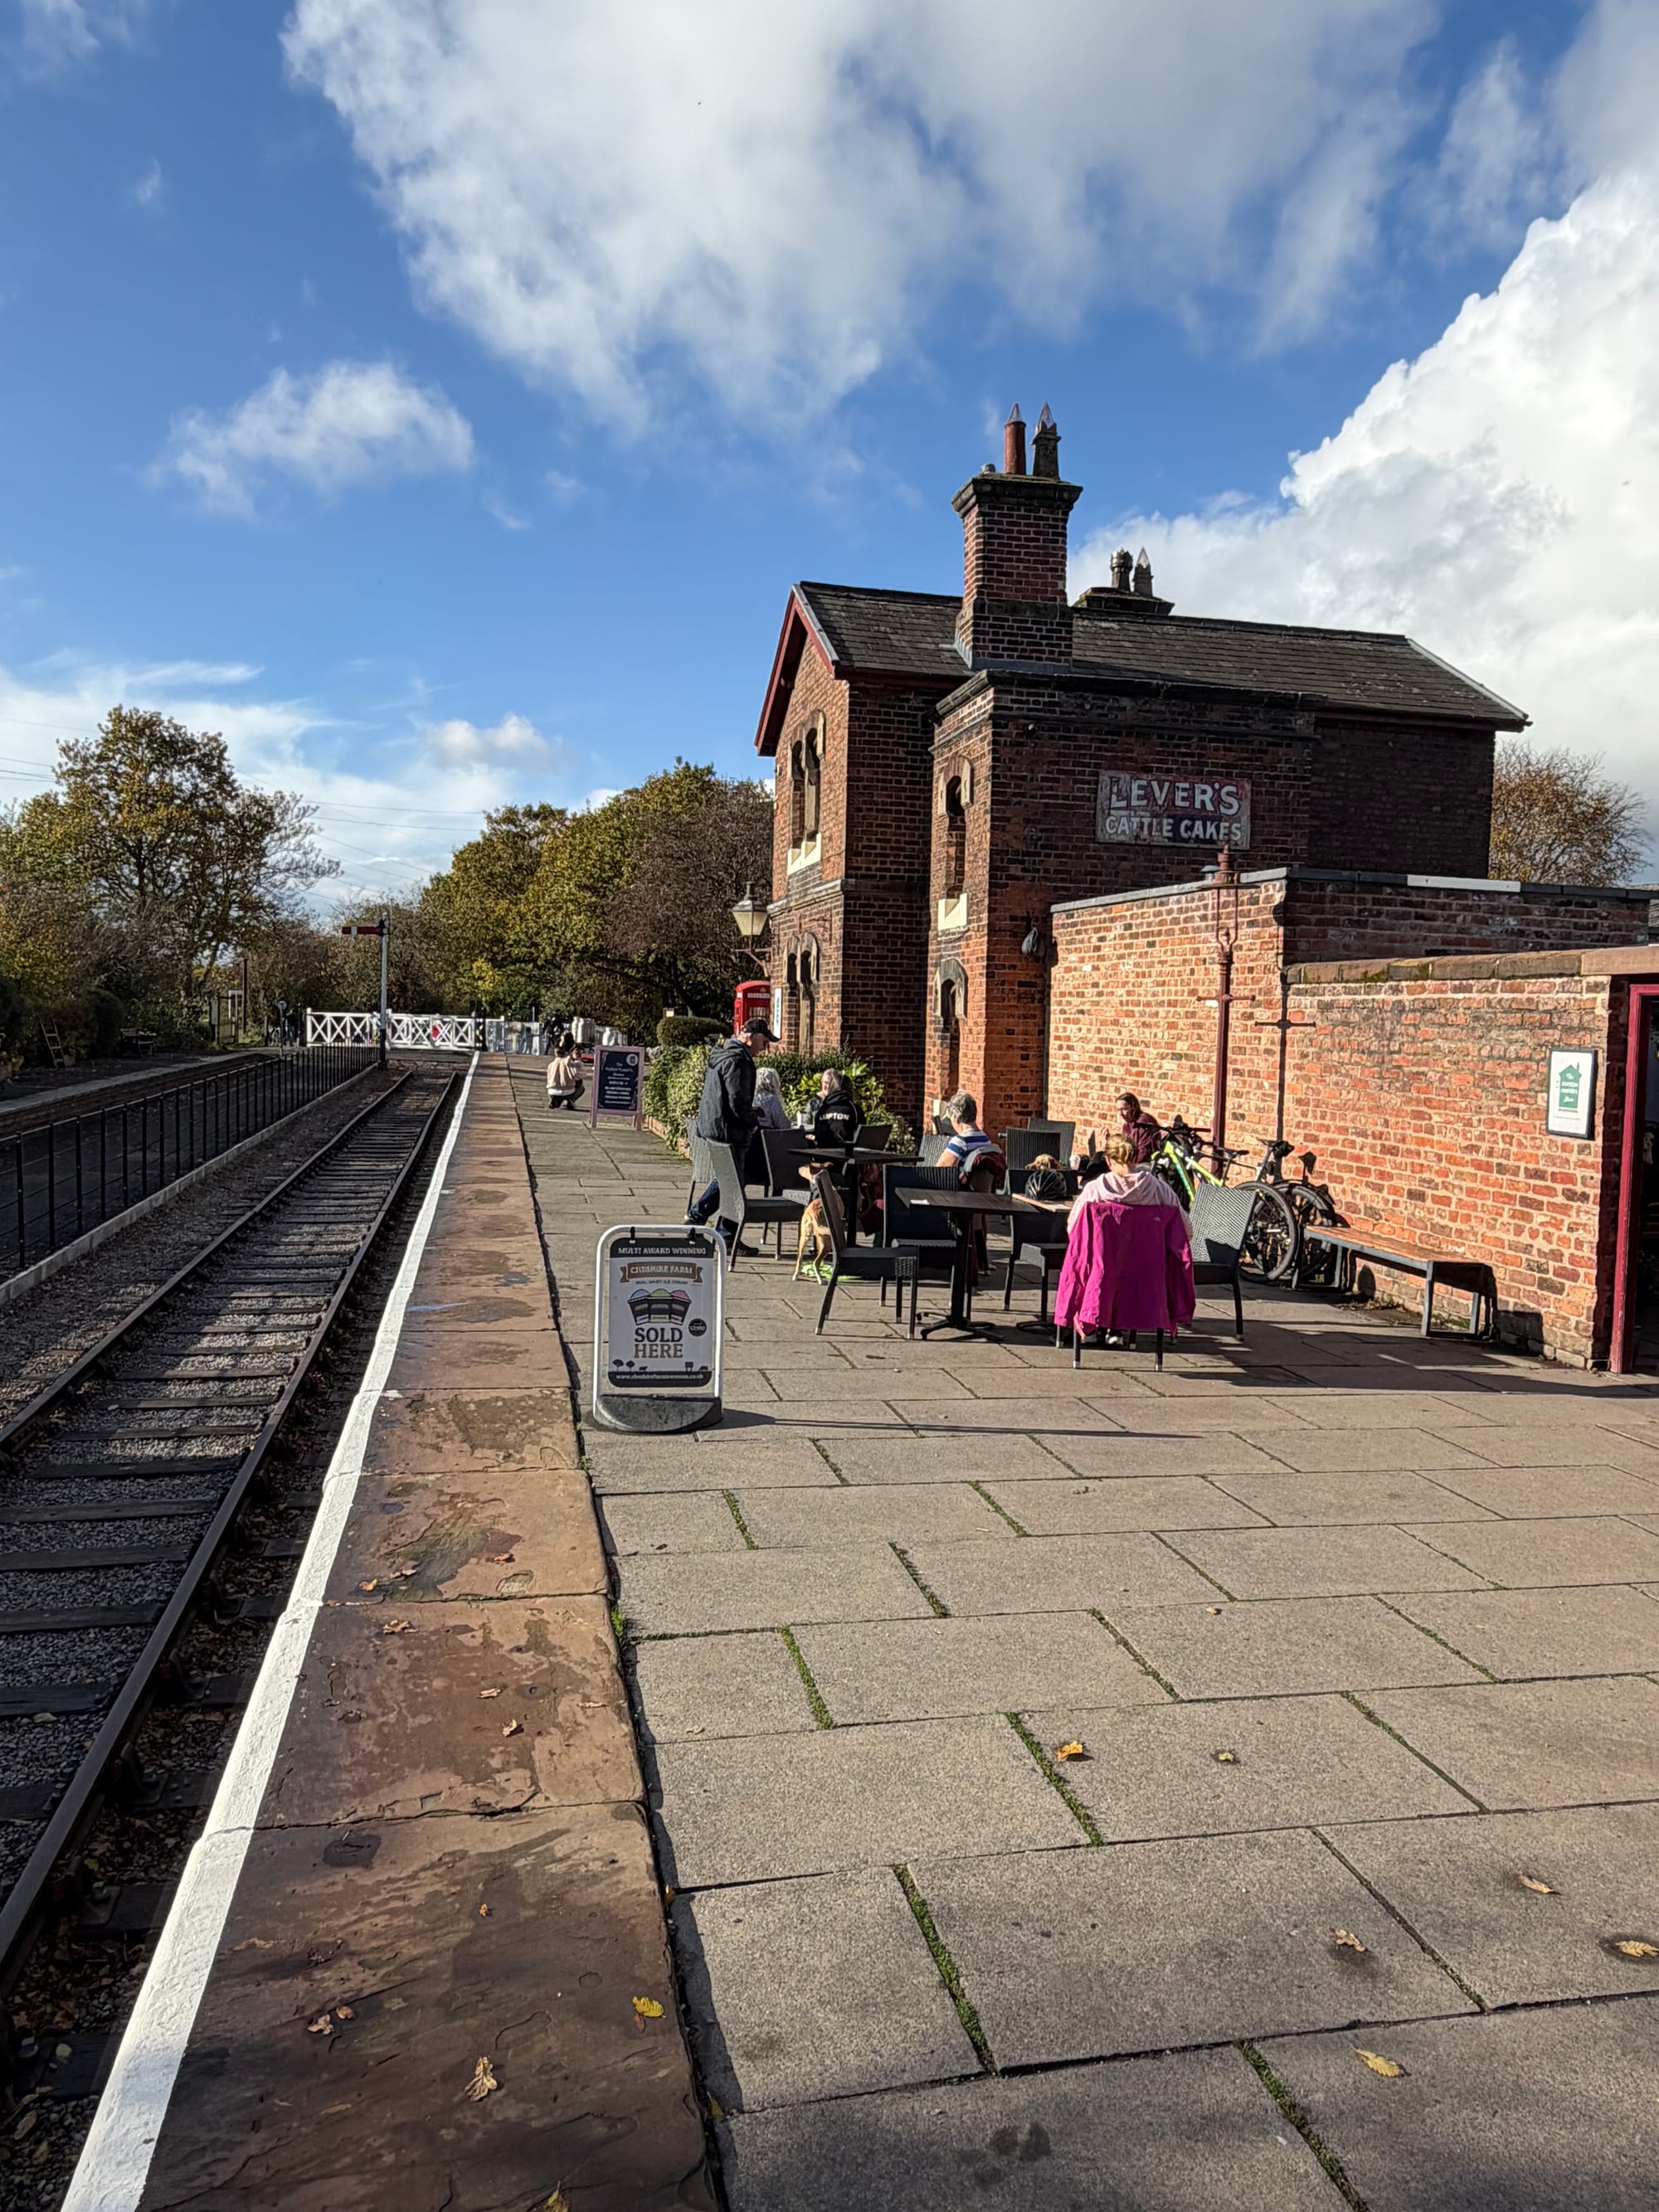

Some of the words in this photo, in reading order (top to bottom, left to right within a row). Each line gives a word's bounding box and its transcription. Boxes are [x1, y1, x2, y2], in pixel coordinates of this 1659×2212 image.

[1110, 778, 1241, 815] LEVER'S
[1105, 816, 1174, 838] CATTLE
[618, 1247, 641, 1255] MULTI
[643, 1247, 670, 1255] AWARD
[672, 1247, 707, 1255] WINNING
[630, 1266, 669, 1274] CHESHIRE
[669, 1266, 693, 1274] FARM
[634, 1327, 683, 1343] SOLD
[634, 1344, 684, 1359] HERE
